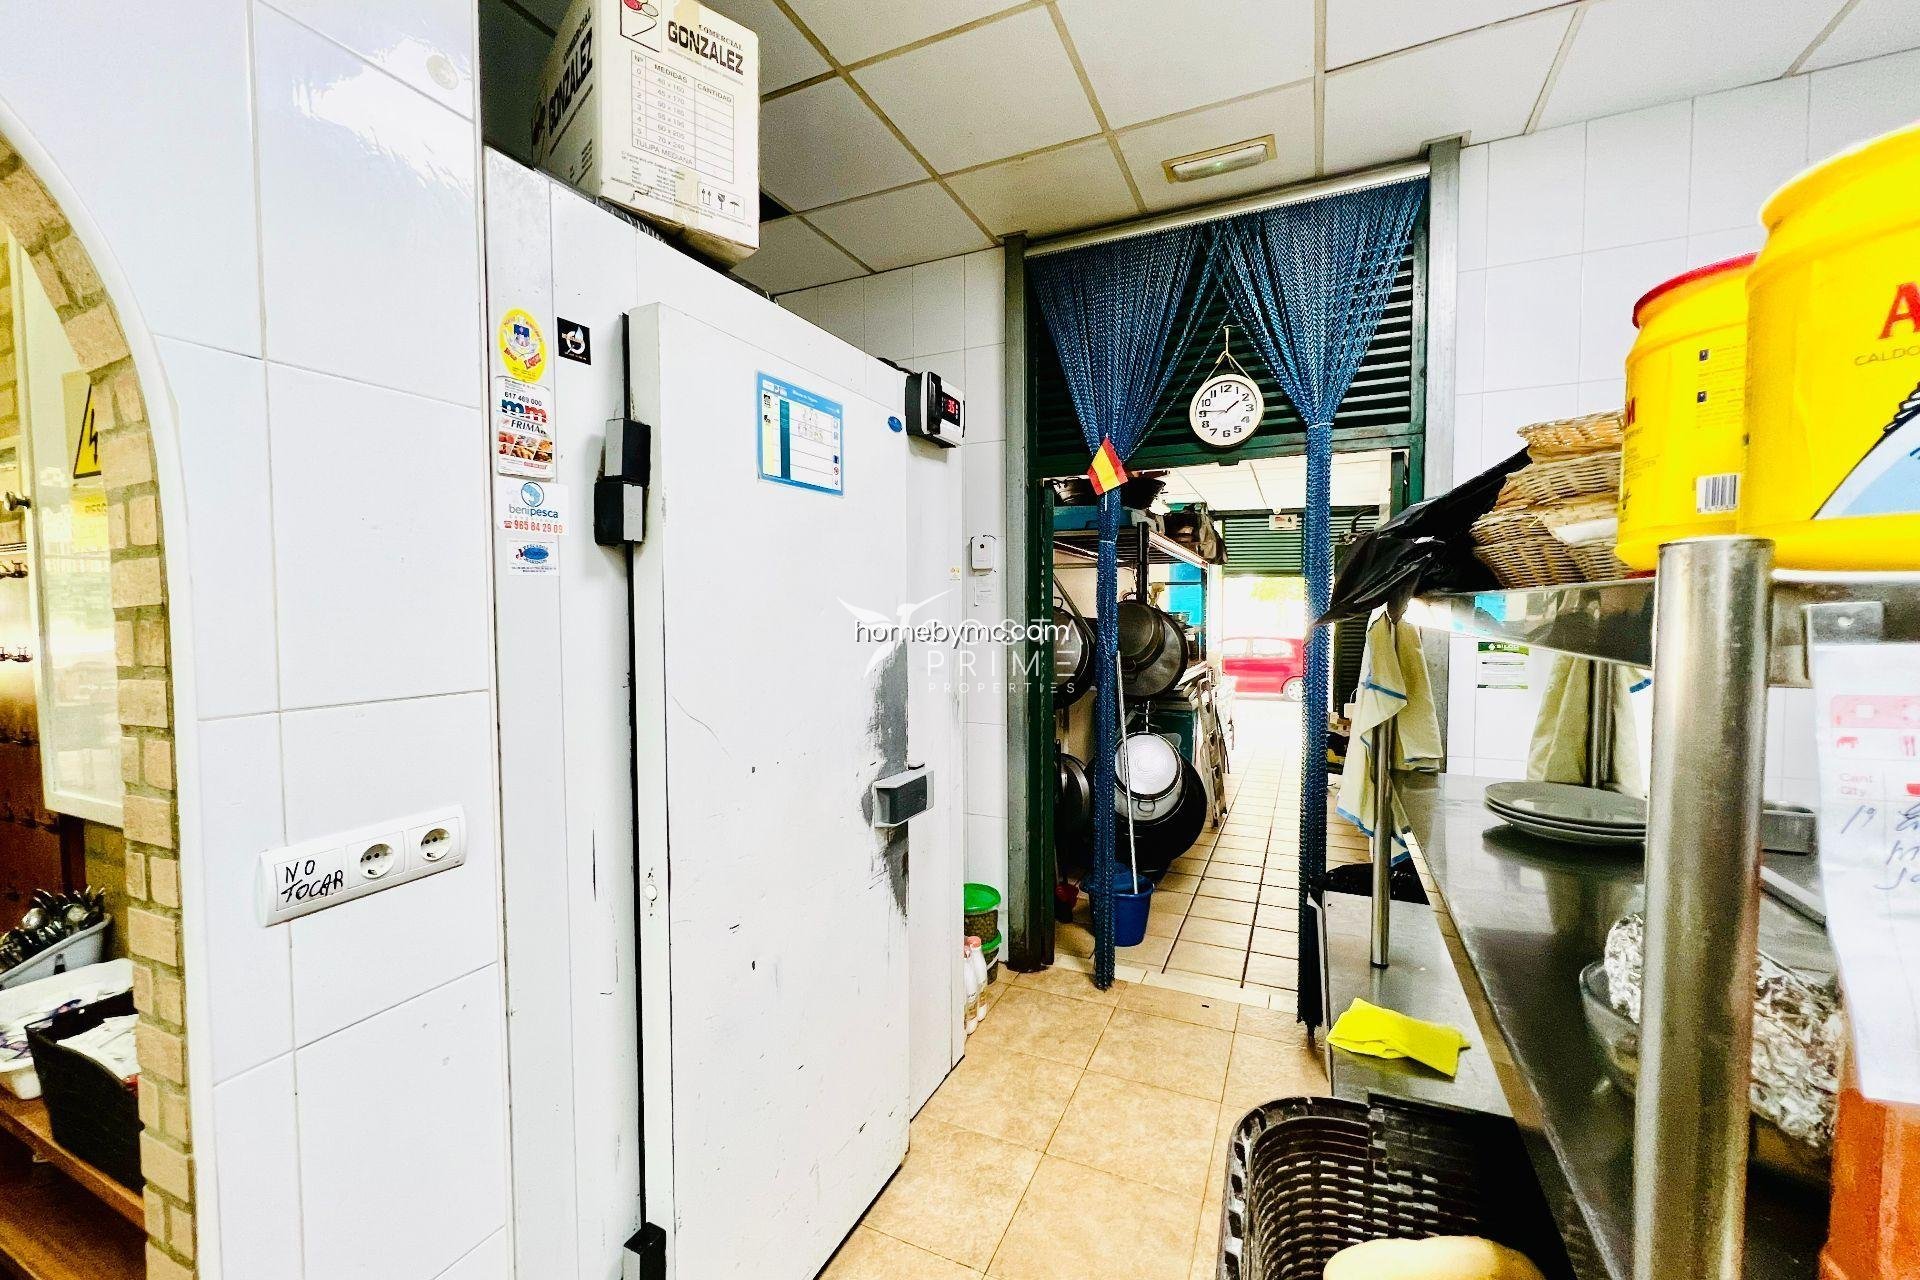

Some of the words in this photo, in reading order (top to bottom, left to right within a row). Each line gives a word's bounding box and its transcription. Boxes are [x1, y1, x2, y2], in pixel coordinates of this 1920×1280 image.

[698, 24, 743, 51] COMERCIAL
[667, 20, 744, 76] GONZALEZ
[654, 63, 688, 84] MEDIDAS
[697, 83, 732, 103] CANTIDAD
[657, 78, 666, 86] 40
[657, 136, 666, 144] 70
[635, 139, 660, 153] TULIPA
[661, 147, 693, 165] MEDIANA
[1221, 384, 1232, 393] 12
[1211, 390, 1216, 398] 11
[1242, 393, 1249, 401] 2
[1202, 399, 1211, 407] 10
[1246, 404, 1254, 412] 3
[1199, 410, 1206, 418] 9
[1202, 420, 1209, 428] 8
[1210, 428, 1217, 436] 7
[508, 504, 559, 519] benipesca
[514, 519, 529, 530] 965
[531, 521, 540, 532] 84
[280, 869, 344, 903] TOCAR
